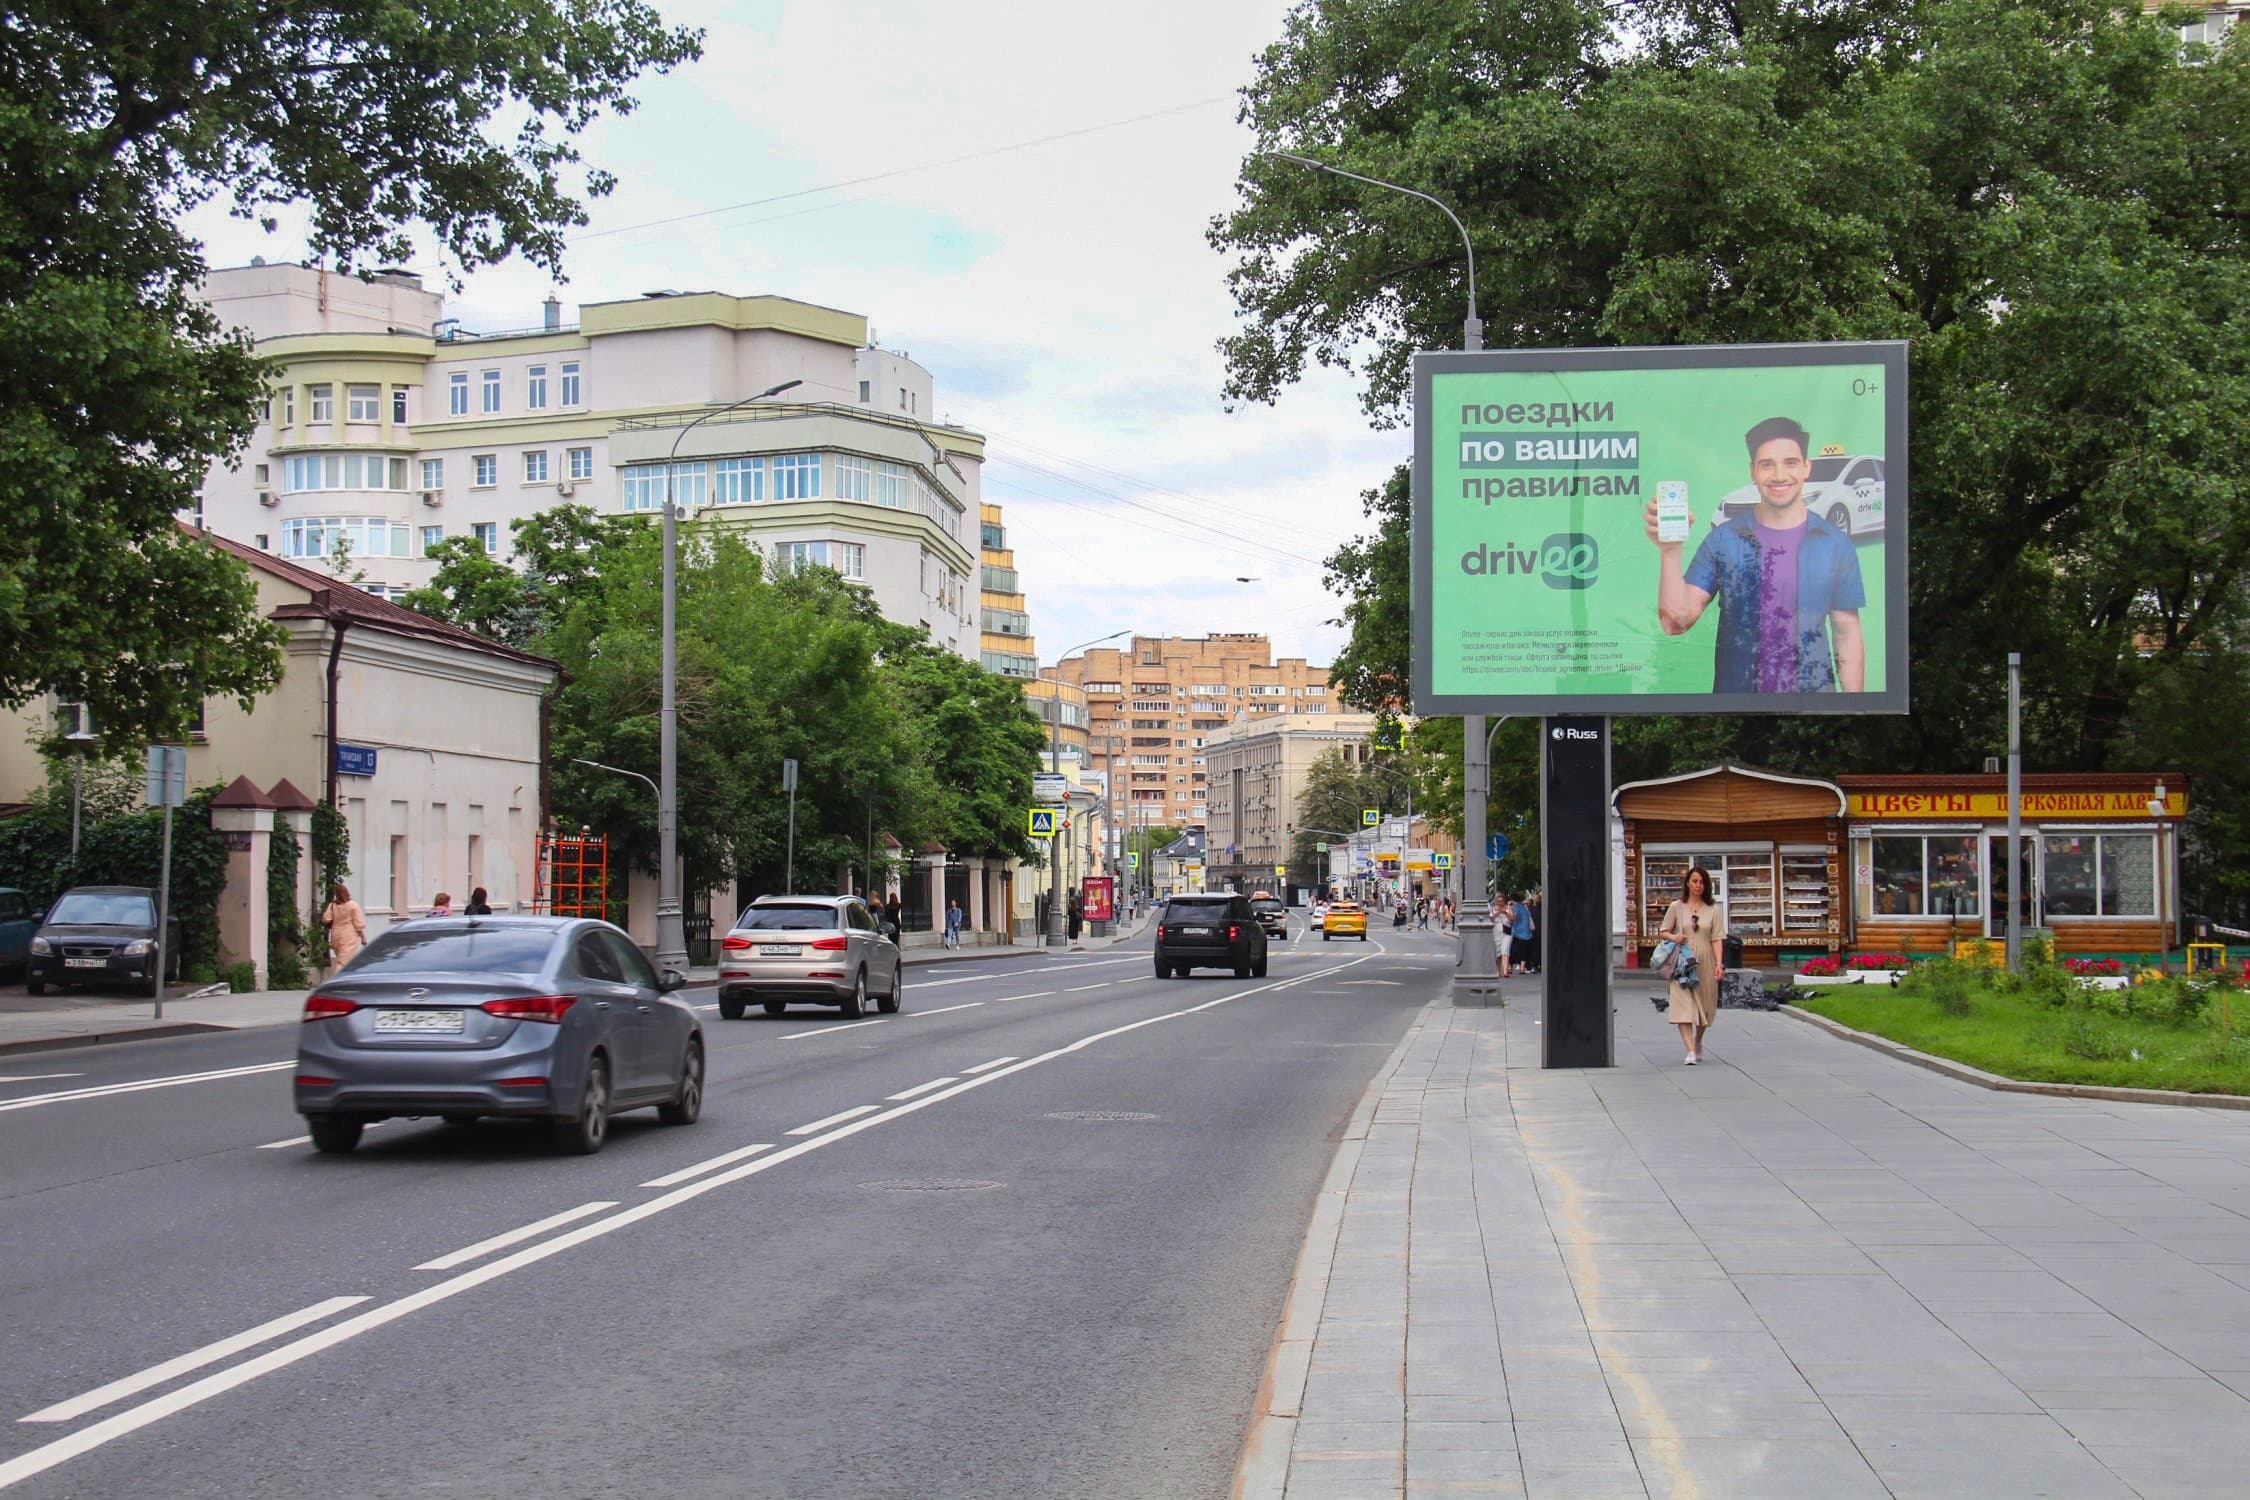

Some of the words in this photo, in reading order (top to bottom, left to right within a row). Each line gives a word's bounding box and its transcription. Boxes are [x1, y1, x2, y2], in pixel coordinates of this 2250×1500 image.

[1852, 378, 1879, 397] 0+
[1461, 401, 1614, 428] поездки
[1461, 440, 1505, 462] по
[1514, 437, 1637, 462] вашим
[1462, 474, 1640, 506] правилам
[1460, 541, 1600, 580] drivee
[1566, 728, 1598, 739] Russ
[1860, 794, 1973, 816] ЦВЕТЫ
[1996, 794, 2105, 811] ЦРКОВНАЯ
